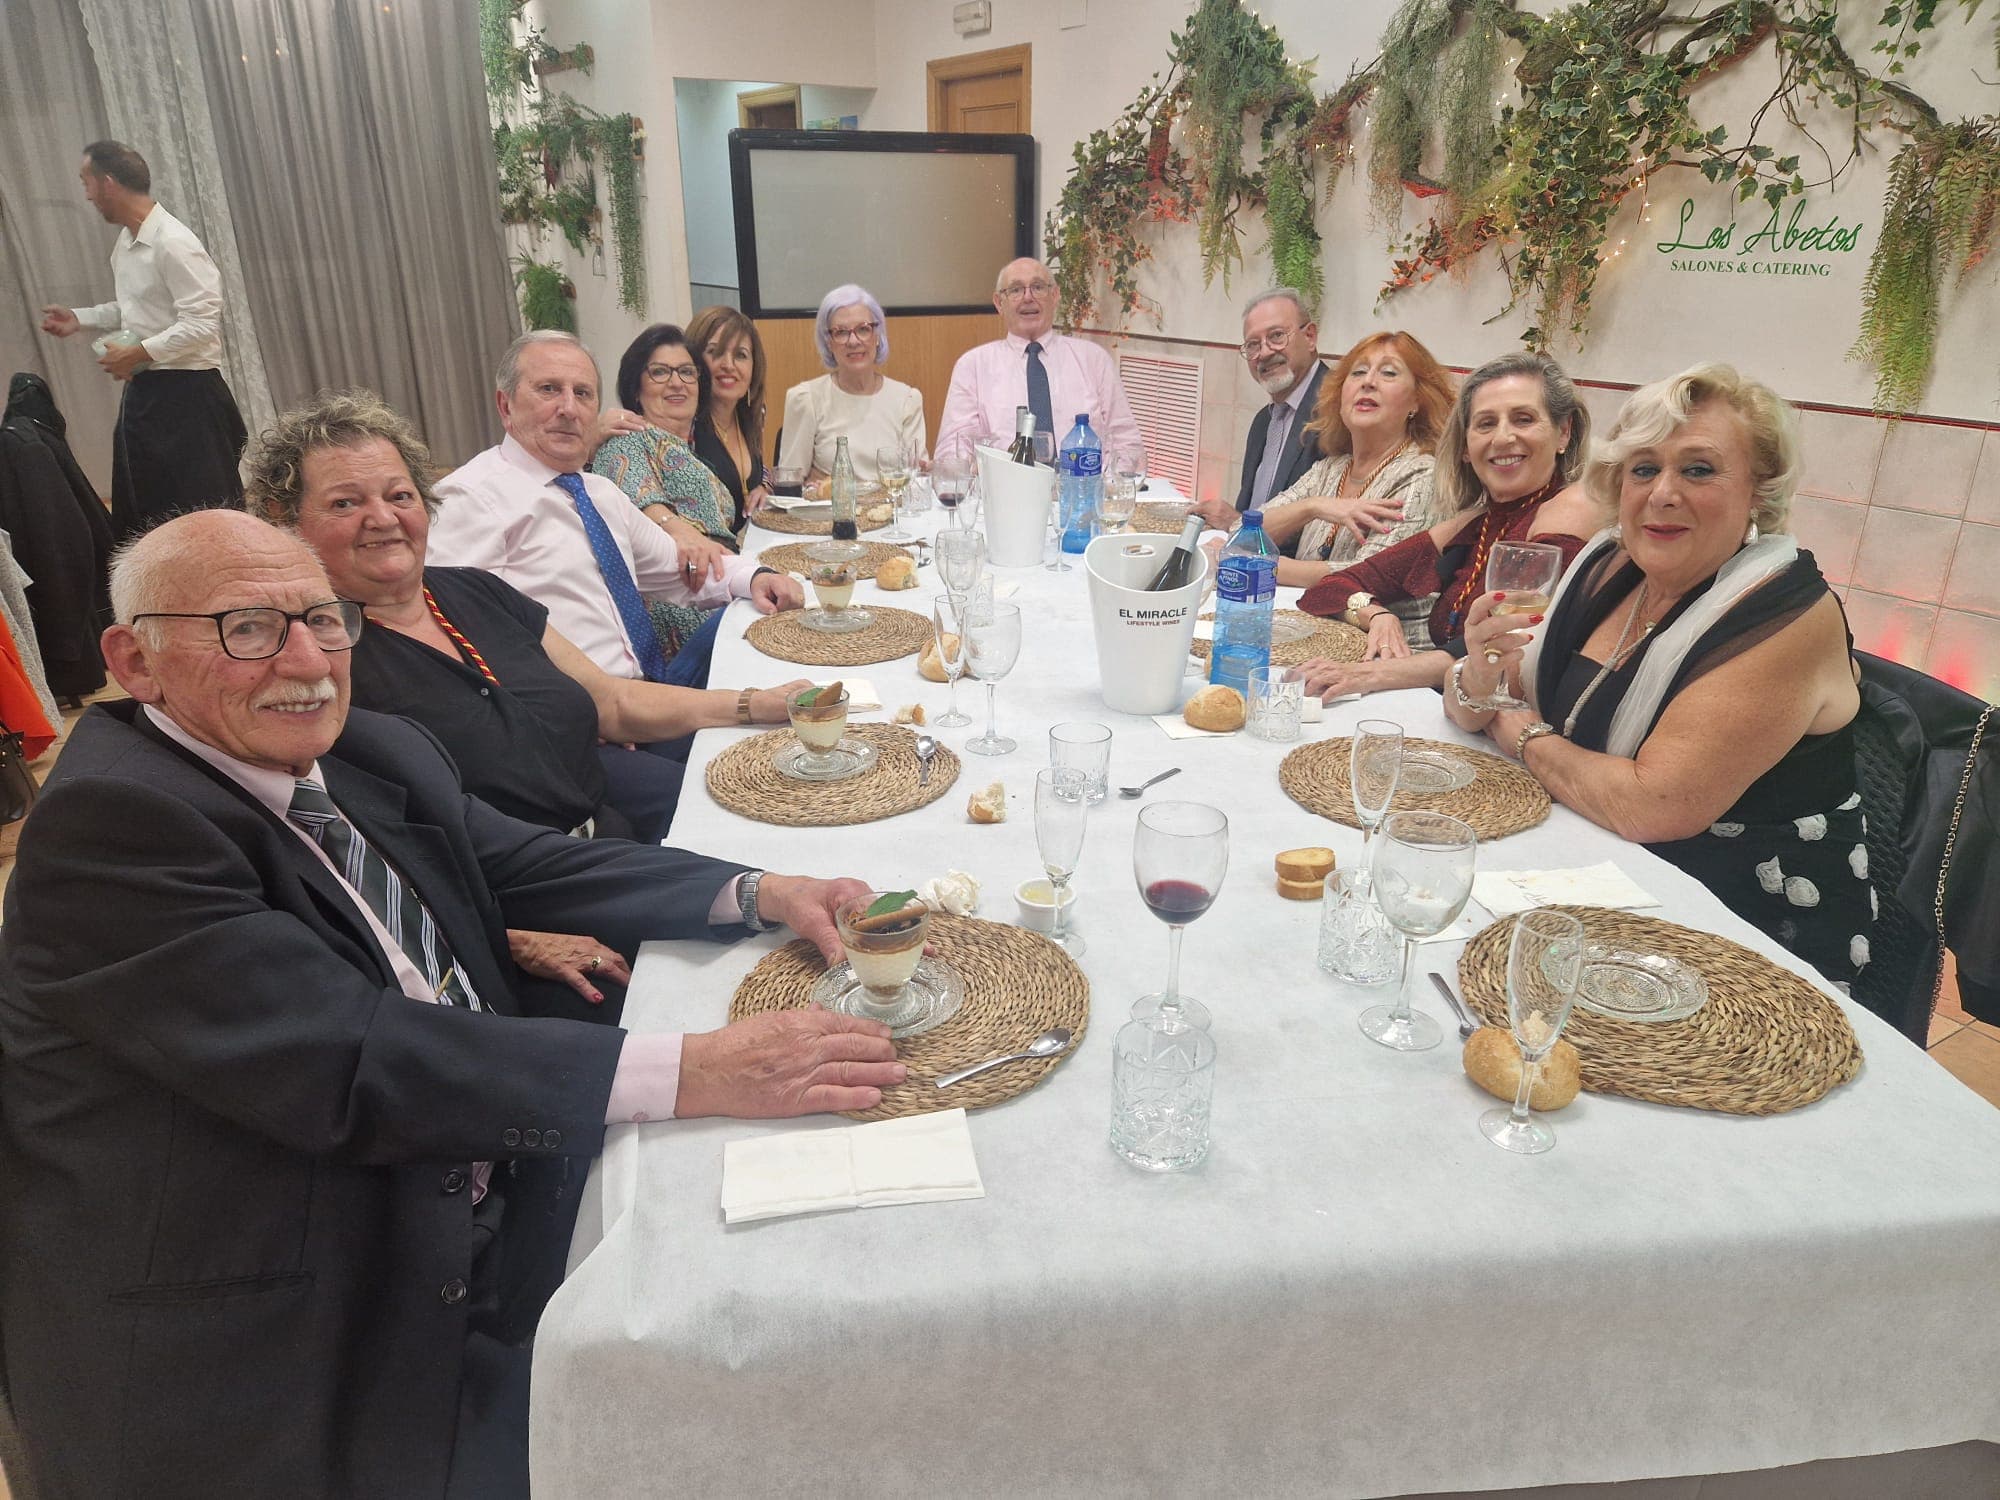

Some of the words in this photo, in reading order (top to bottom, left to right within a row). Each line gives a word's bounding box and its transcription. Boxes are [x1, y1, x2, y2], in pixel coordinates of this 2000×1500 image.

[1656, 198, 1736, 254] Los
[1736, 198, 1864, 256] Abetos
[1670, 259, 1734, 273] SALONES
[1736, 261, 1749, 274] &
[1752, 261, 1832, 277] CATERING
[1119, 608, 1134, 619] EL
[1136, 606, 1188, 619] MIRACLE
[1126, 619, 1160, 627] LIFESTYLE
